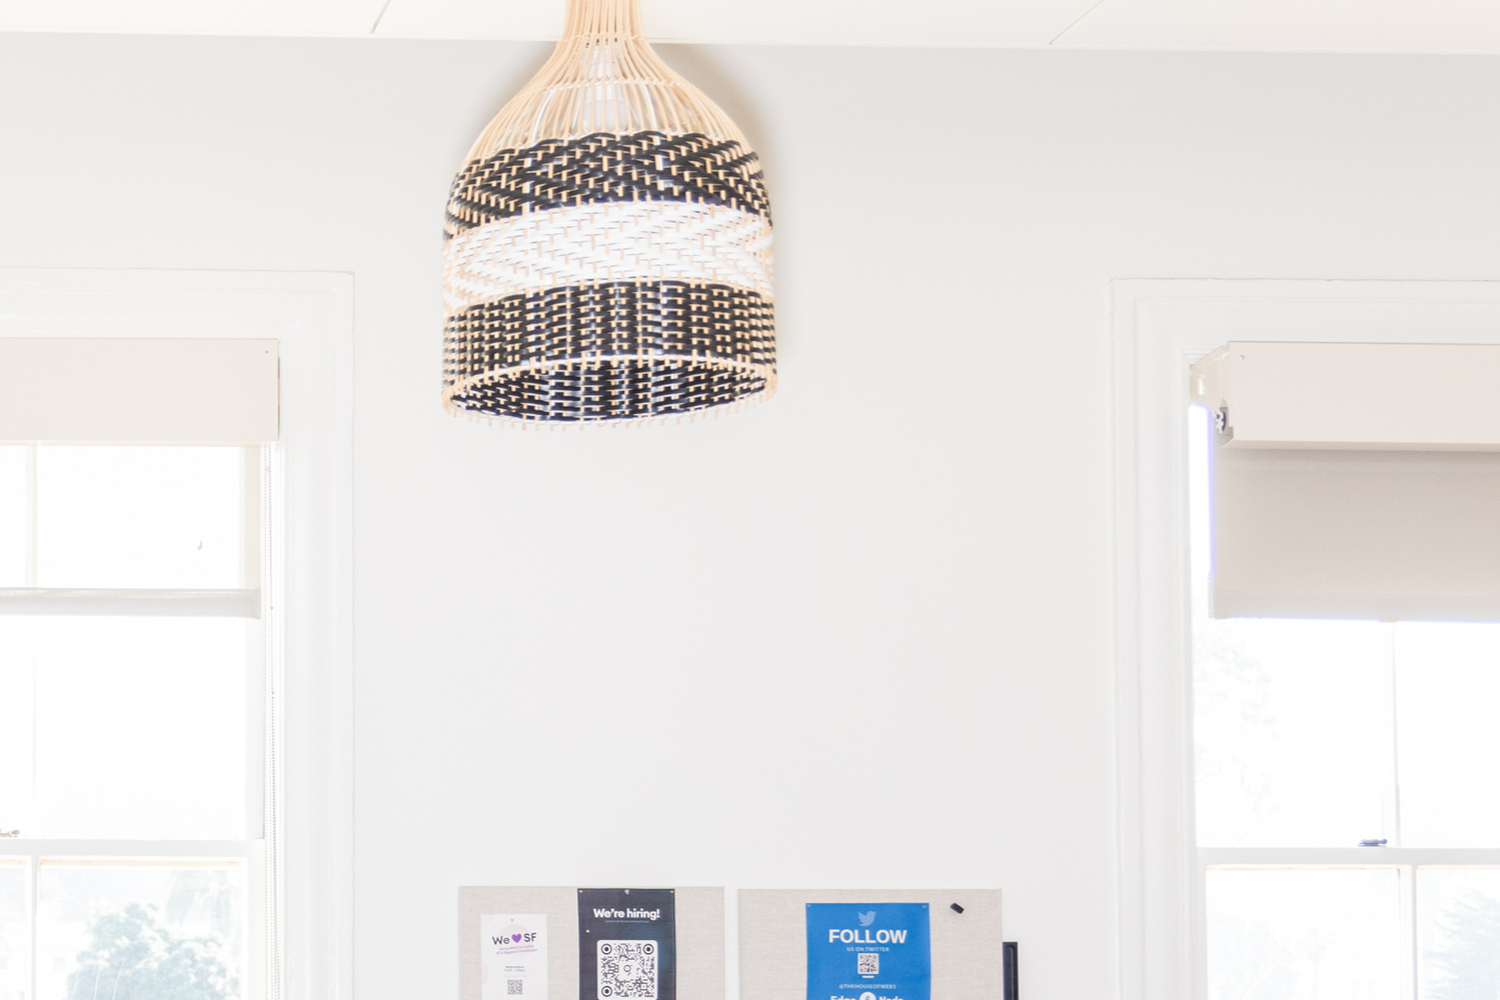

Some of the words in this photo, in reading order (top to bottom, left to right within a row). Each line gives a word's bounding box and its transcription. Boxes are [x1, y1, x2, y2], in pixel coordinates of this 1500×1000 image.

[593, 908, 625, 918] We're
[626, 908, 660, 921] hiring!
[492, 935, 510, 945] We
[524, 932, 537, 943] SF
[828, 929, 907, 944] FOLLOW
